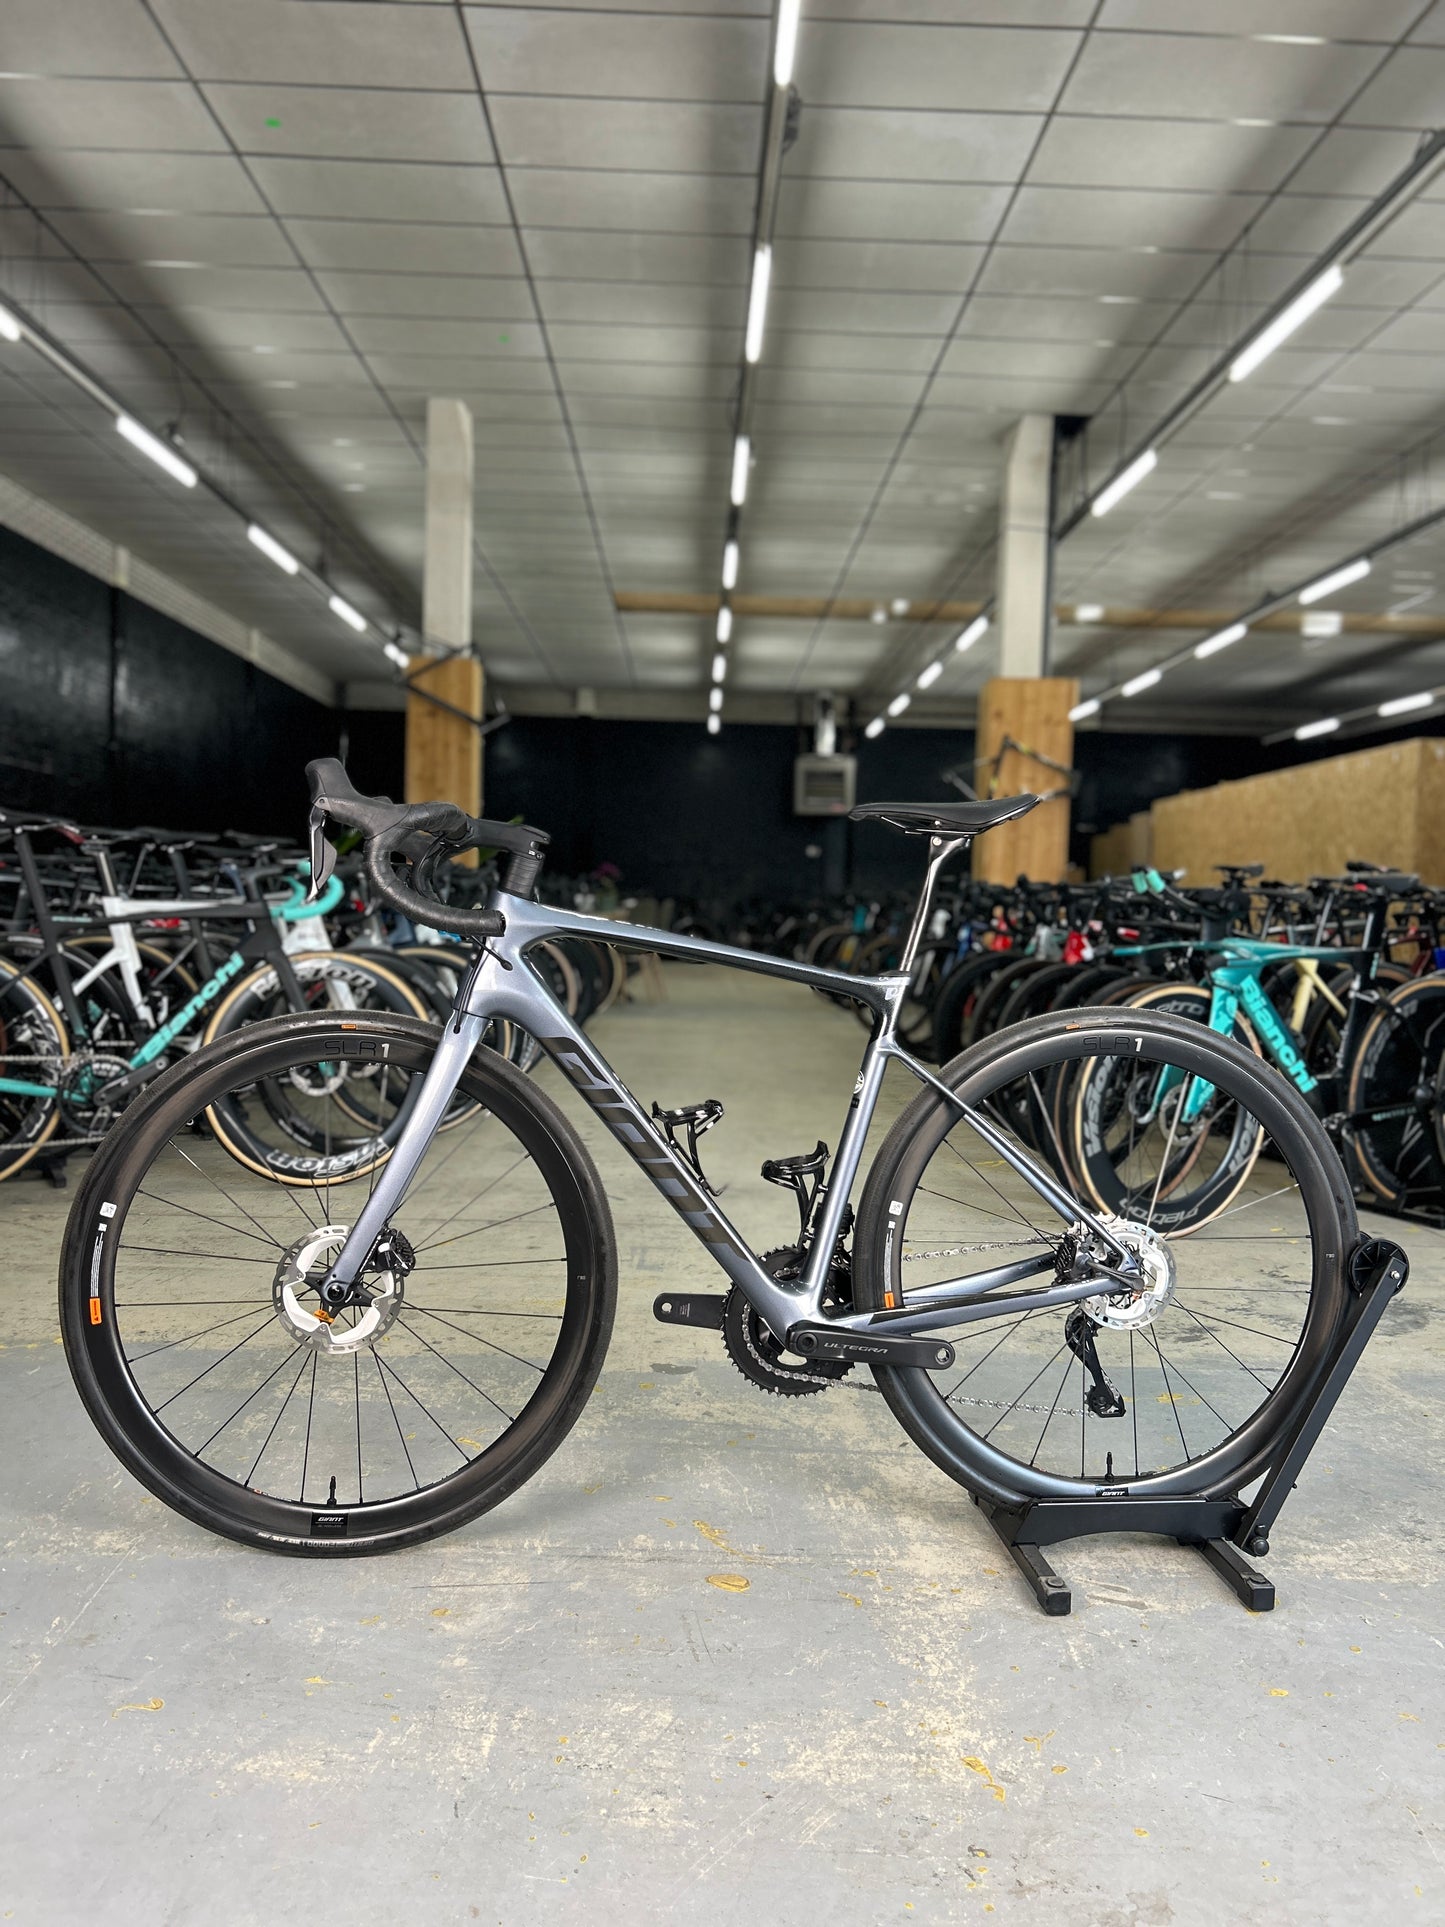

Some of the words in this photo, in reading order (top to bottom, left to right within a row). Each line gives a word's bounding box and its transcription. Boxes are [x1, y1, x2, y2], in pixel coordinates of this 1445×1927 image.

[140, 950, 245, 1063] Bianchi
[1240, 974, 1318, 1094] Bianchi
[324, 1040, 376, 1056] SLR
[1083, 1036, 1131, 1052] SLR
[537, 1036, 751, 1262] GIANT
[823, 1342, 889, 1354] ULTEGRA
